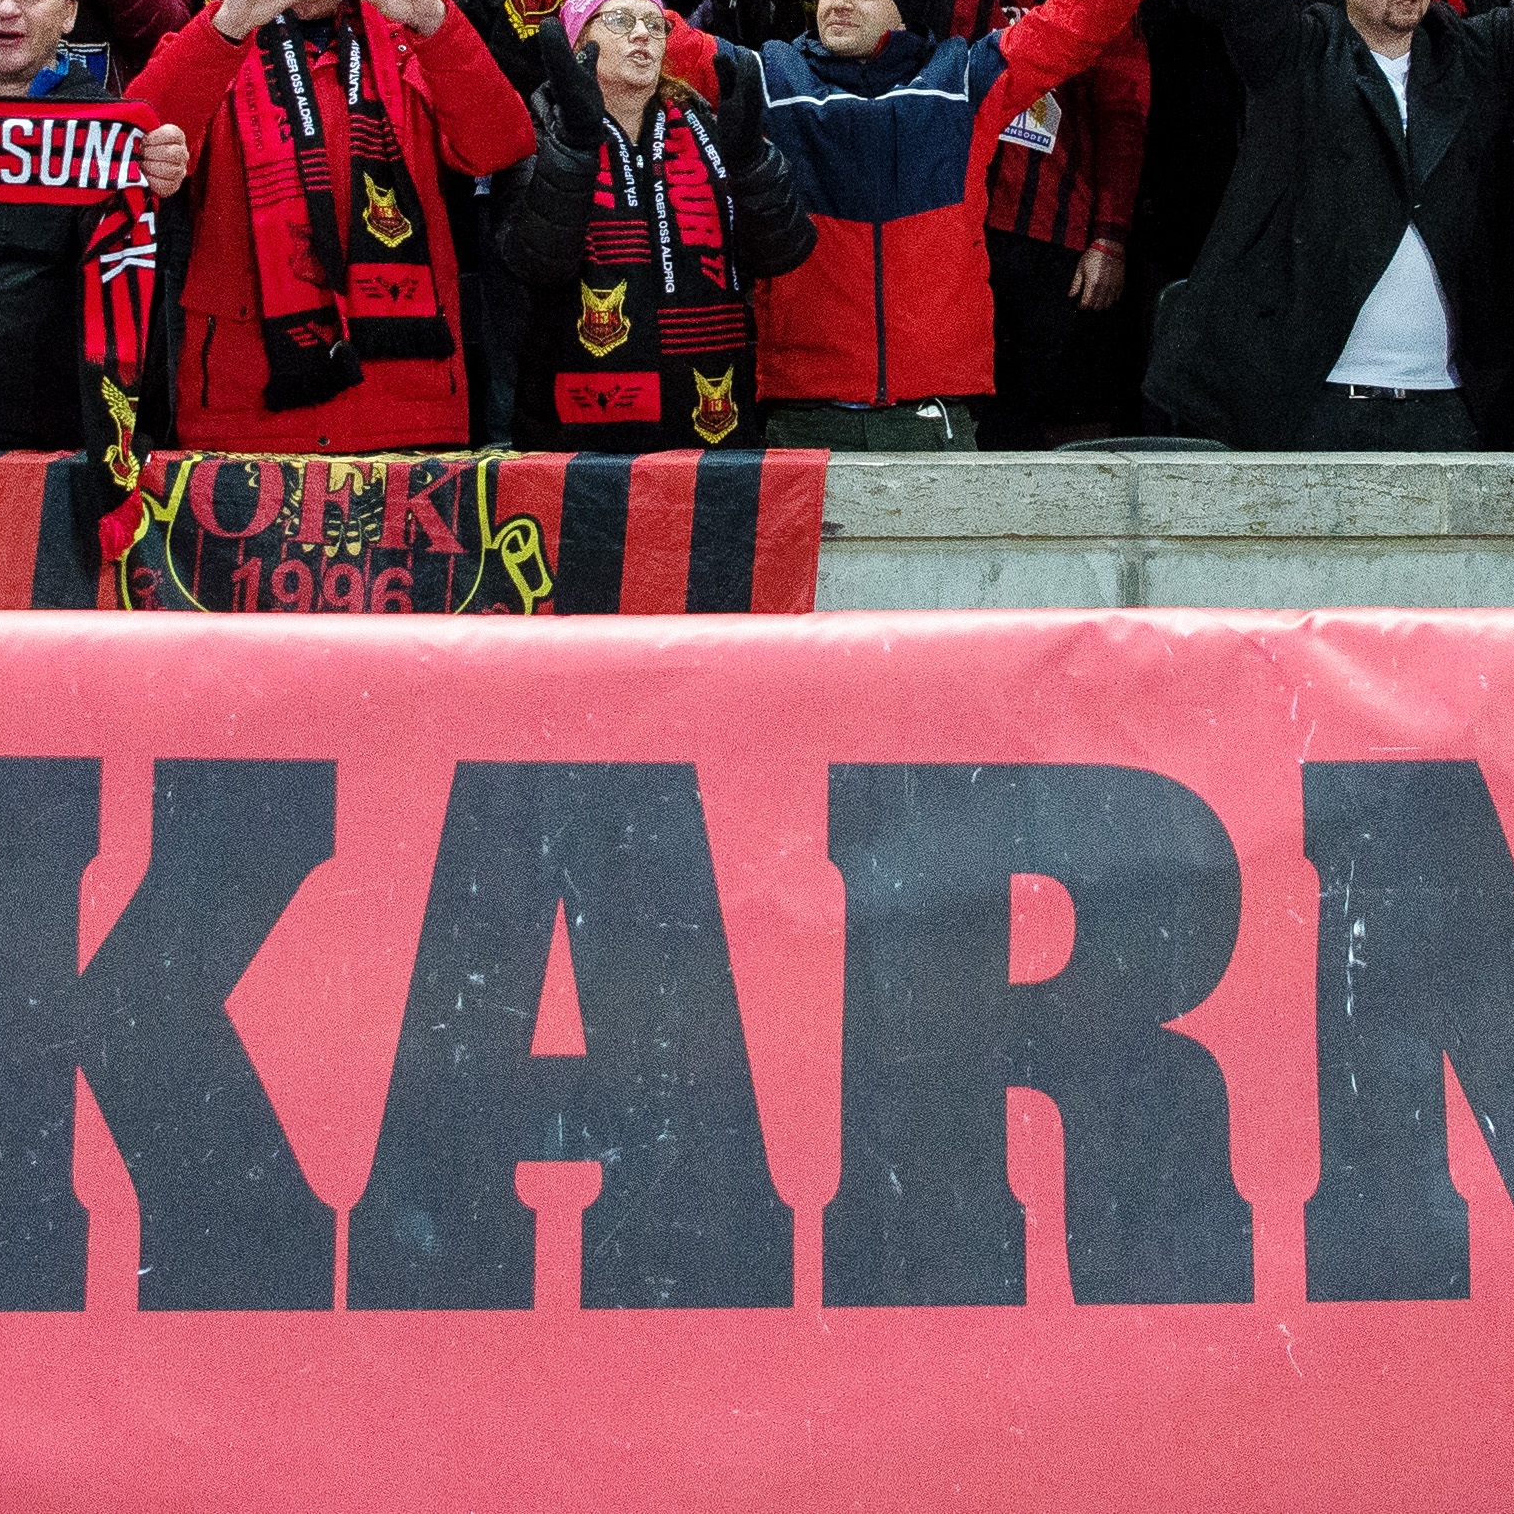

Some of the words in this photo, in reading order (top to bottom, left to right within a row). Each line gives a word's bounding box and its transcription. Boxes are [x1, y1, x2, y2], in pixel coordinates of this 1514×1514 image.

[282, 39, 293, 50] VI
[284, 49, 300, 74] GER
[290, 73, 306, 96] OSS
[296, 95, 316, 137] ALDRIG
[661, 244, 676, 294] ALDRIG
